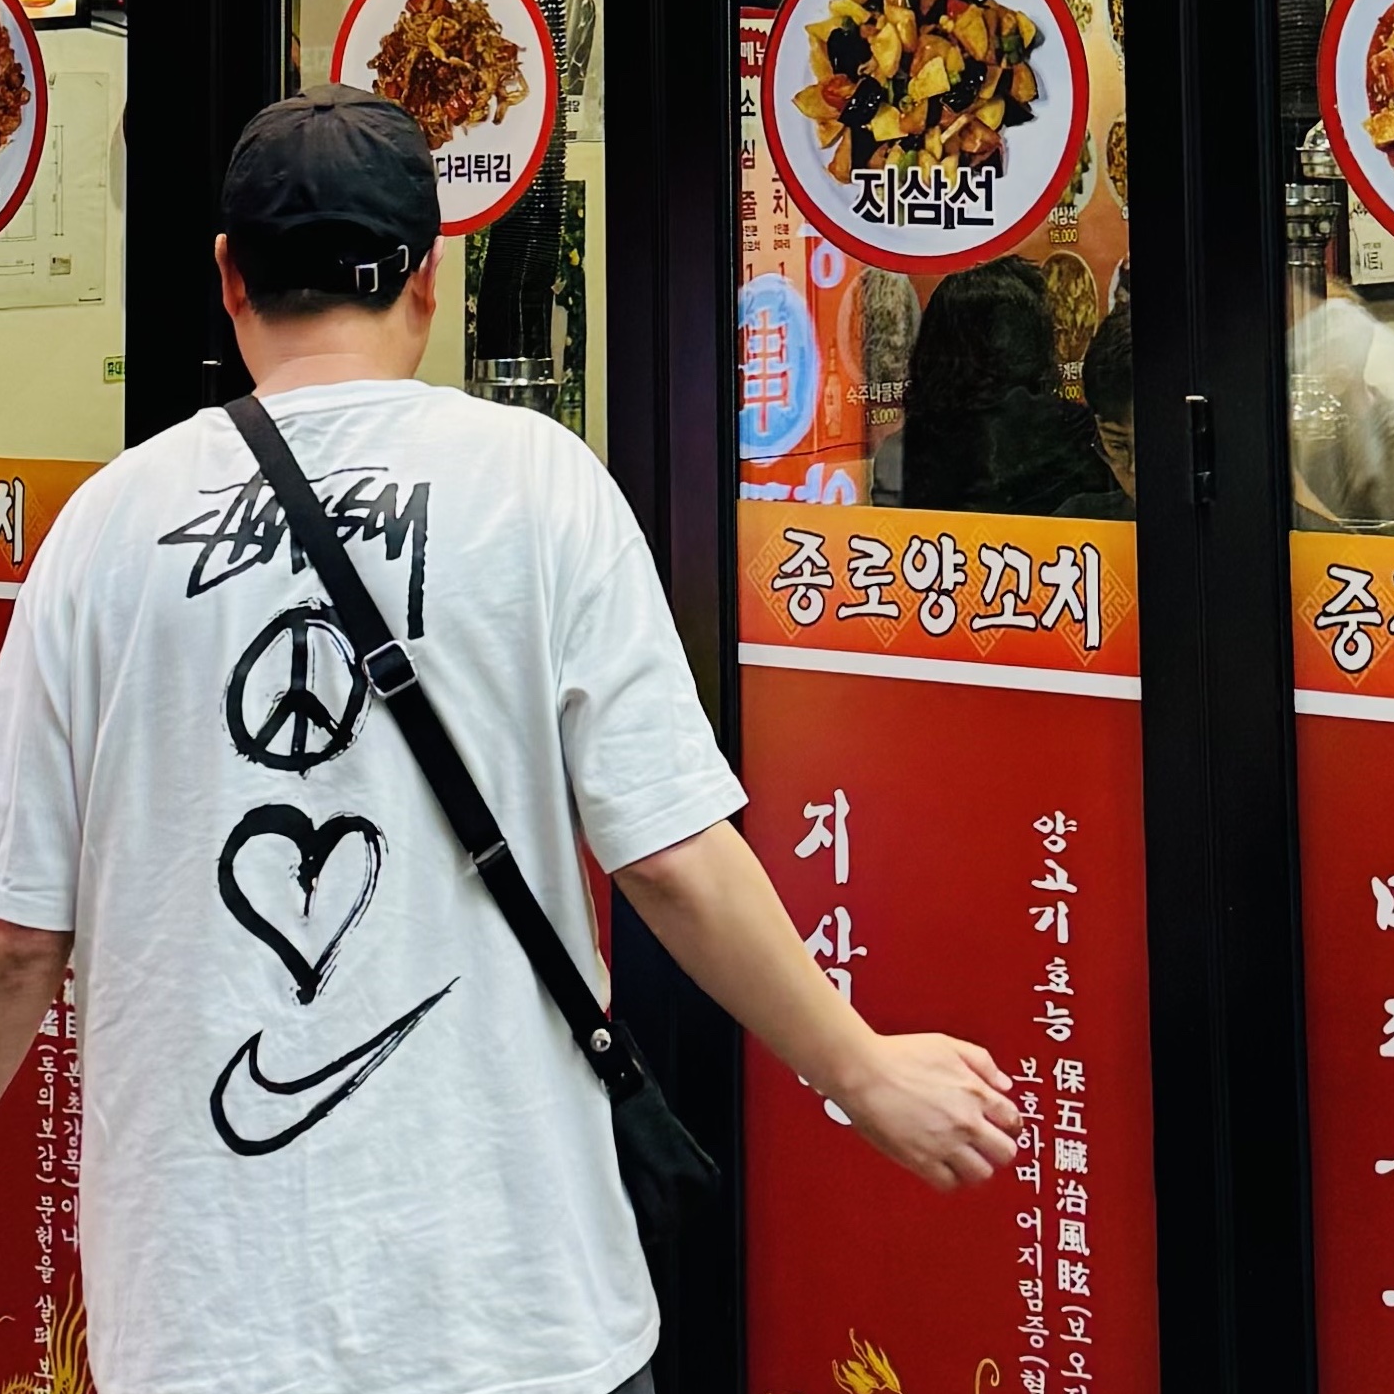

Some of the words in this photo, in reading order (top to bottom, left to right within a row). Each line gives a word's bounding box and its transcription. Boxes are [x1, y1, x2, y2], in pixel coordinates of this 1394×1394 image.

[432, 153, 512, 184] 다리튀김
[852, 167, 996, 227] 지삼선
[847, 380, 911, 404] 숙주나물볶
[771, 526, 1103, 652] 종로양꼬치
[1029, 811, 1078, 944] 양고기
[1033, 956, 1076, 1042] 효능
